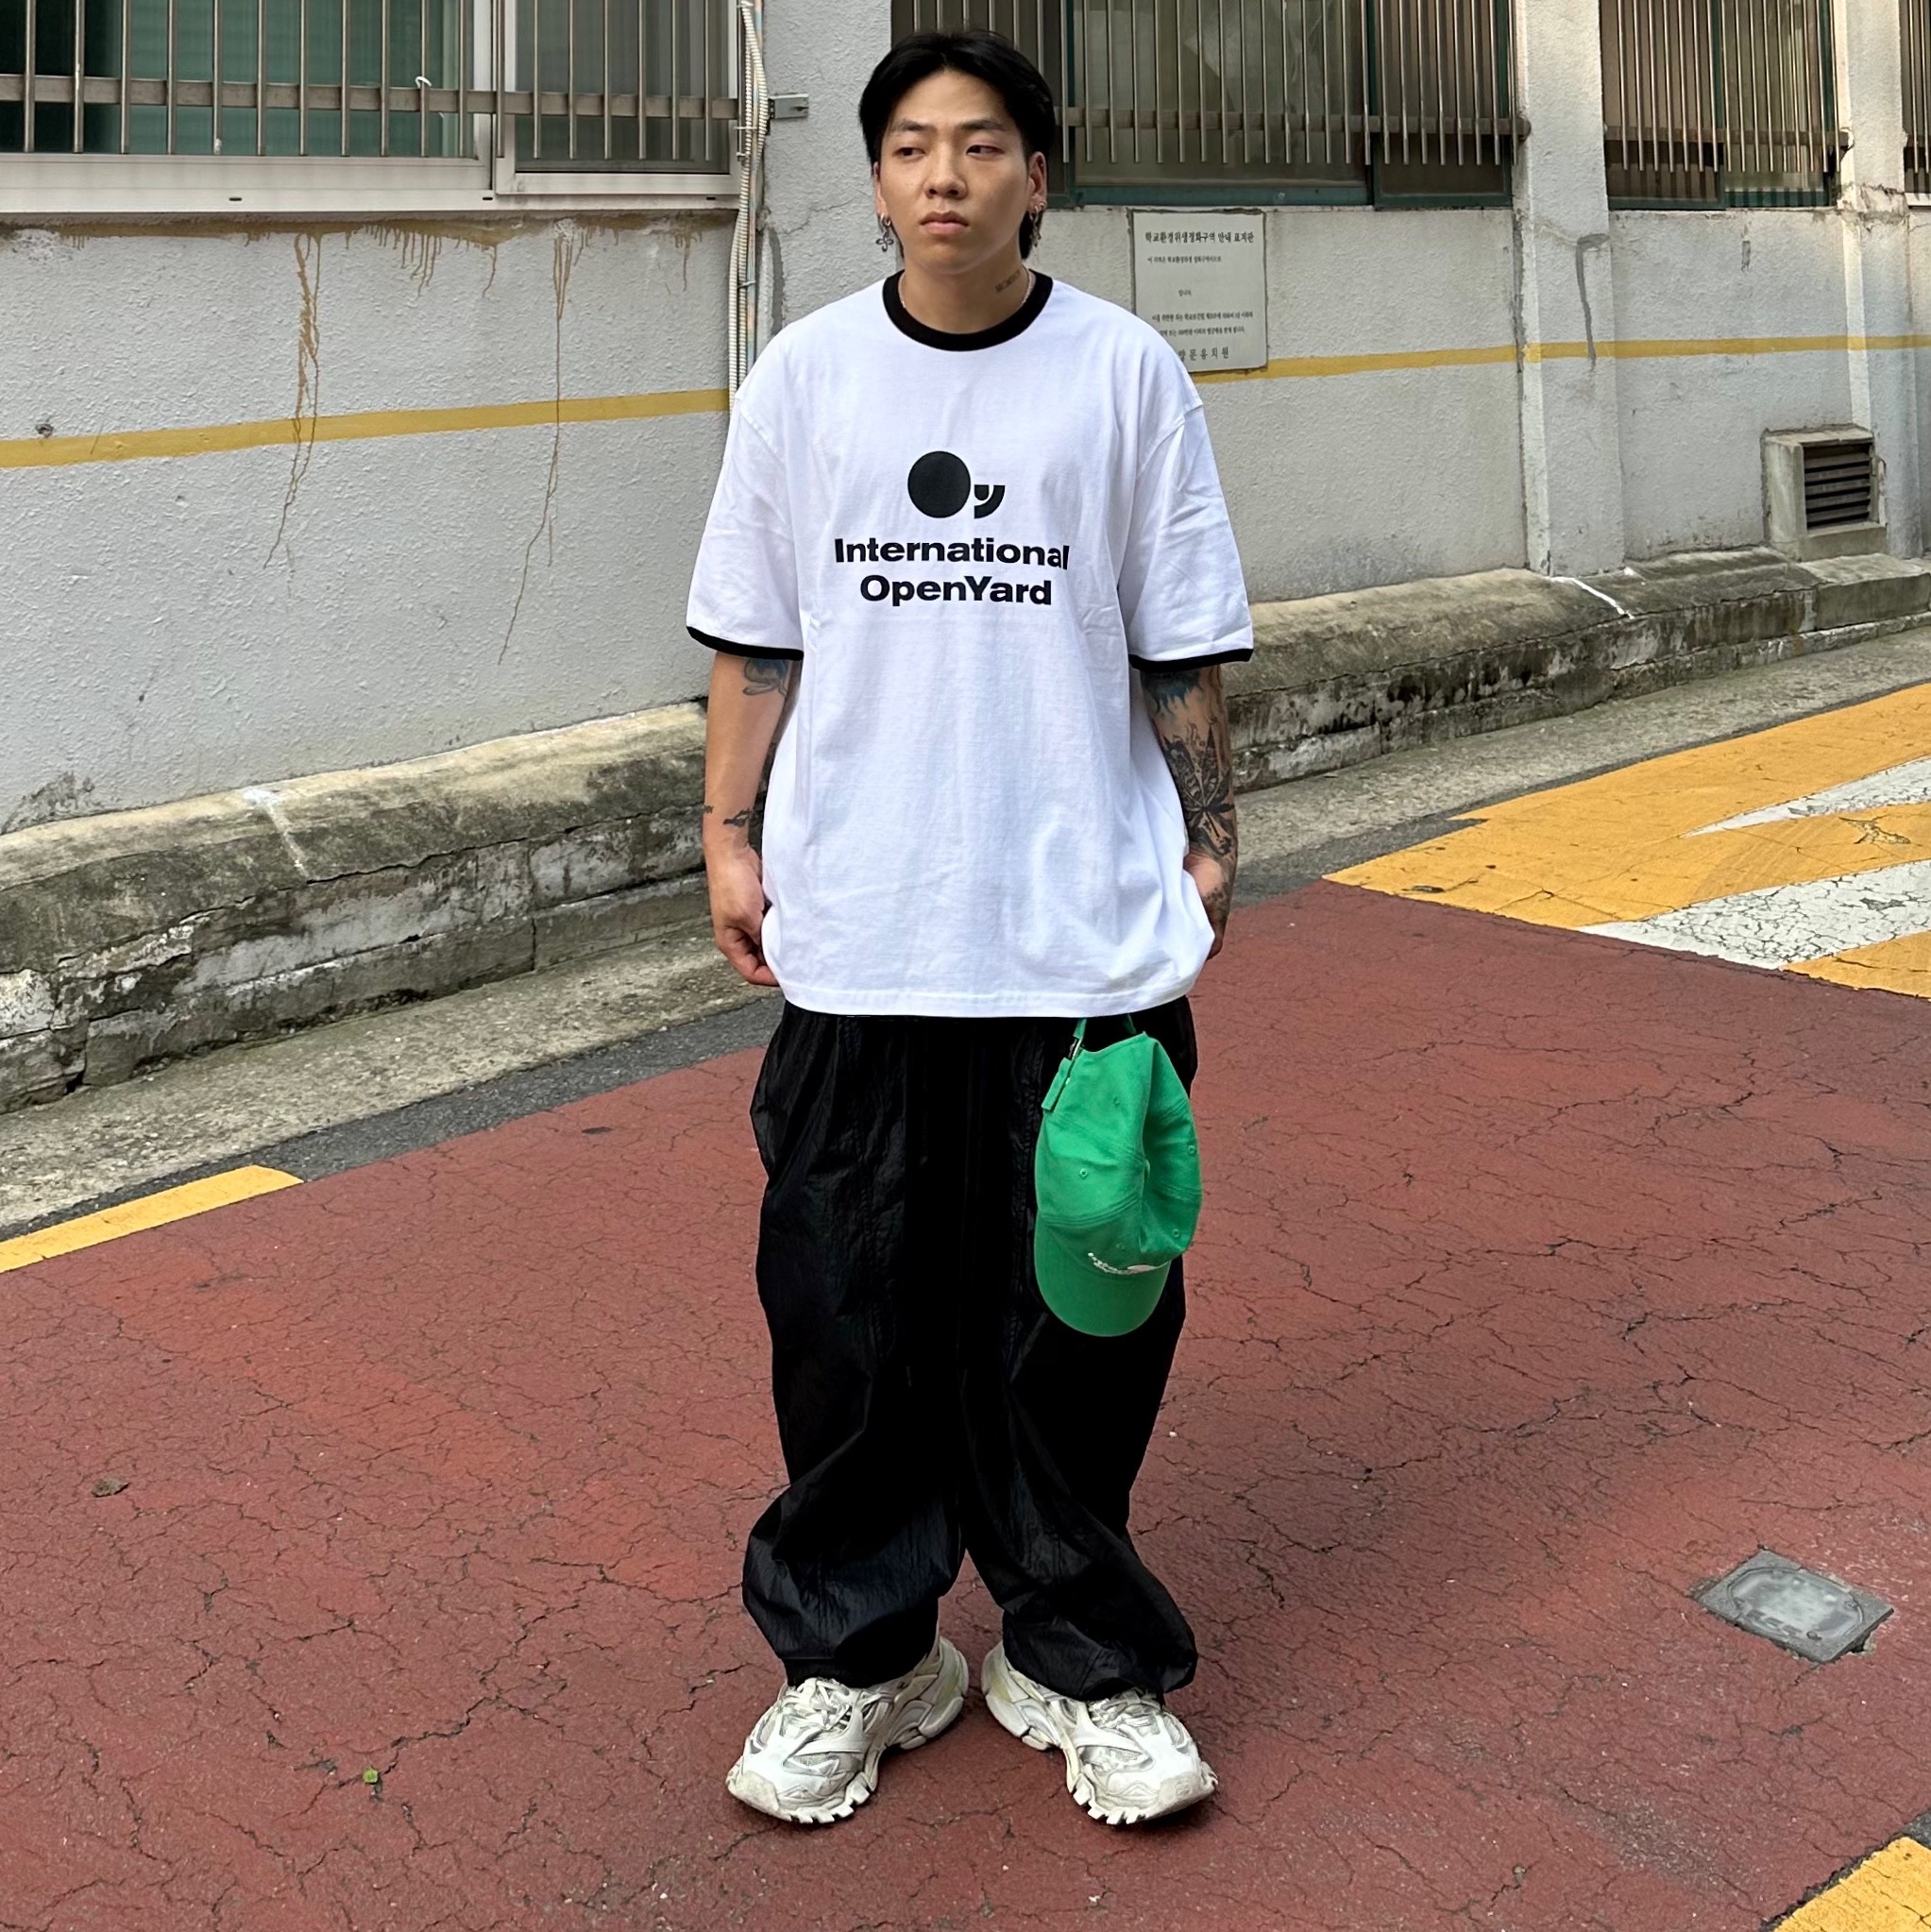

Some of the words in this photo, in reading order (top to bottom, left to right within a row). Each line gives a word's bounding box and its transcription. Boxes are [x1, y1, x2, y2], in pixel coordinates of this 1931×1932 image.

[1217, 230, 1231, 244] 안내
[1234, 230, 1254, 244] 표지판
[834, 536, 1070, 570] International
[859, 574, 1052, 606] OpenYard
